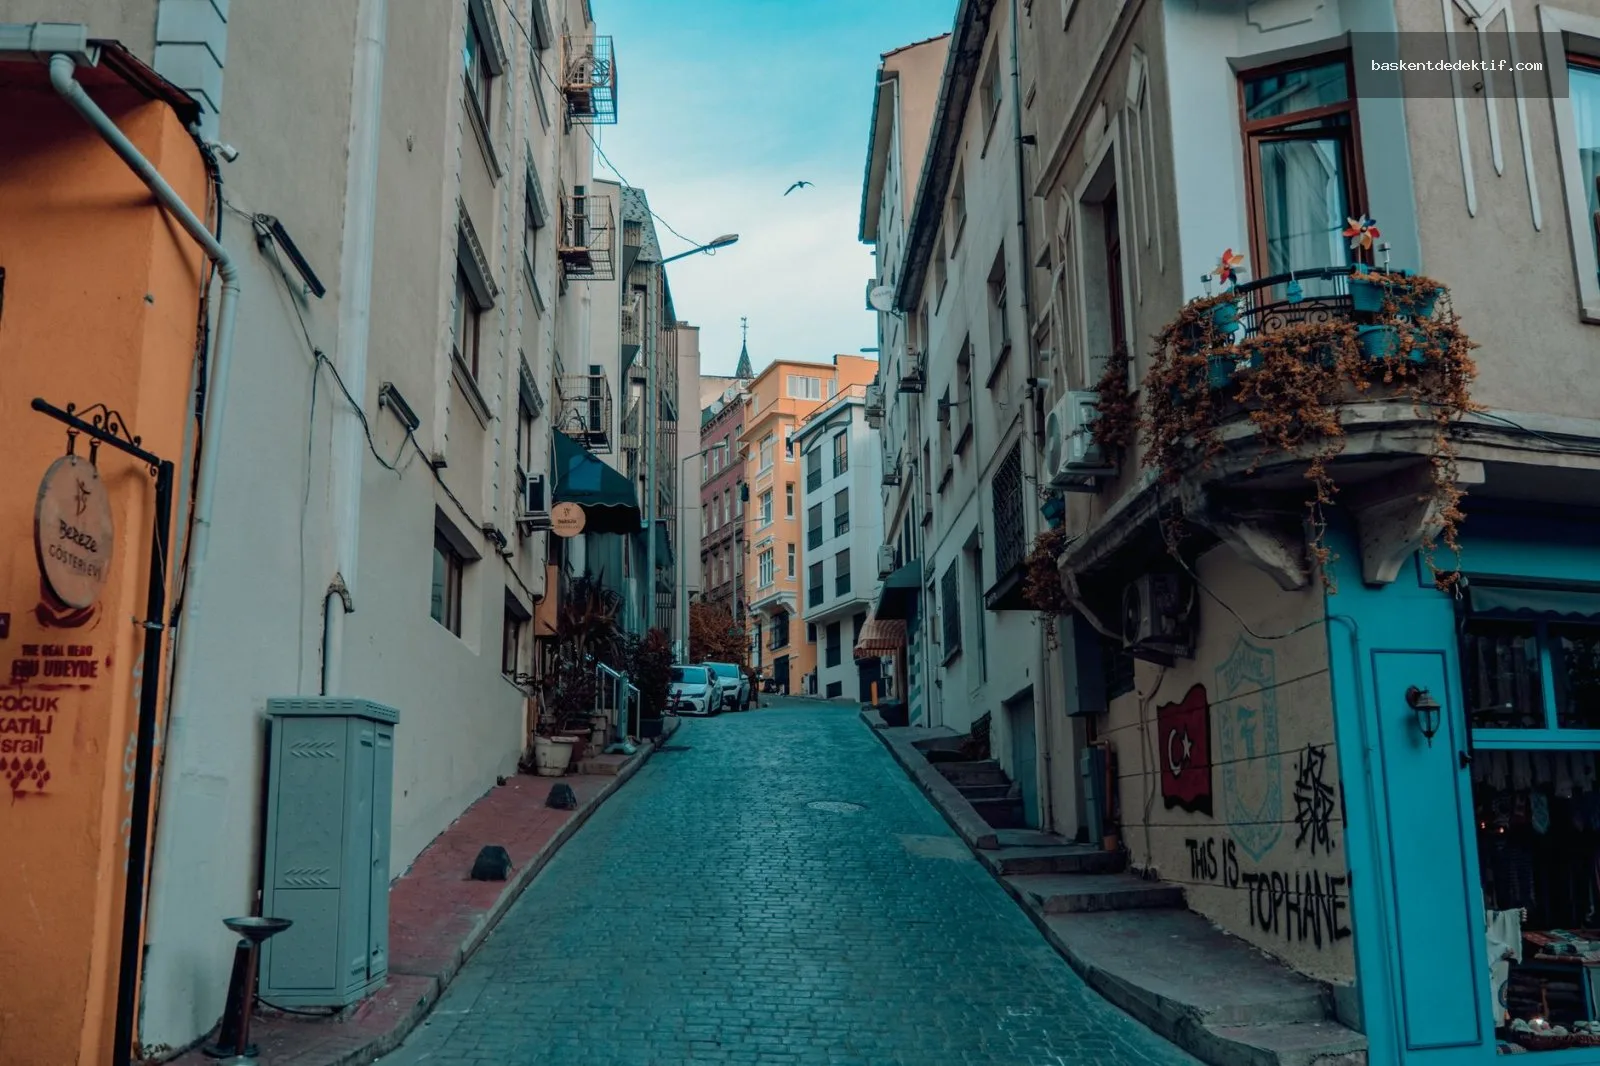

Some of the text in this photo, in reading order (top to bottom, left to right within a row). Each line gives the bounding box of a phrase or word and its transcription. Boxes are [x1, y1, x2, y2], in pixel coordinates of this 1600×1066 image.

[0, 695, 60, 713] OCUK
[0, 735, 44, 754] srail
[1185, 837, 1352, 951] THIS IS TOPHANE
